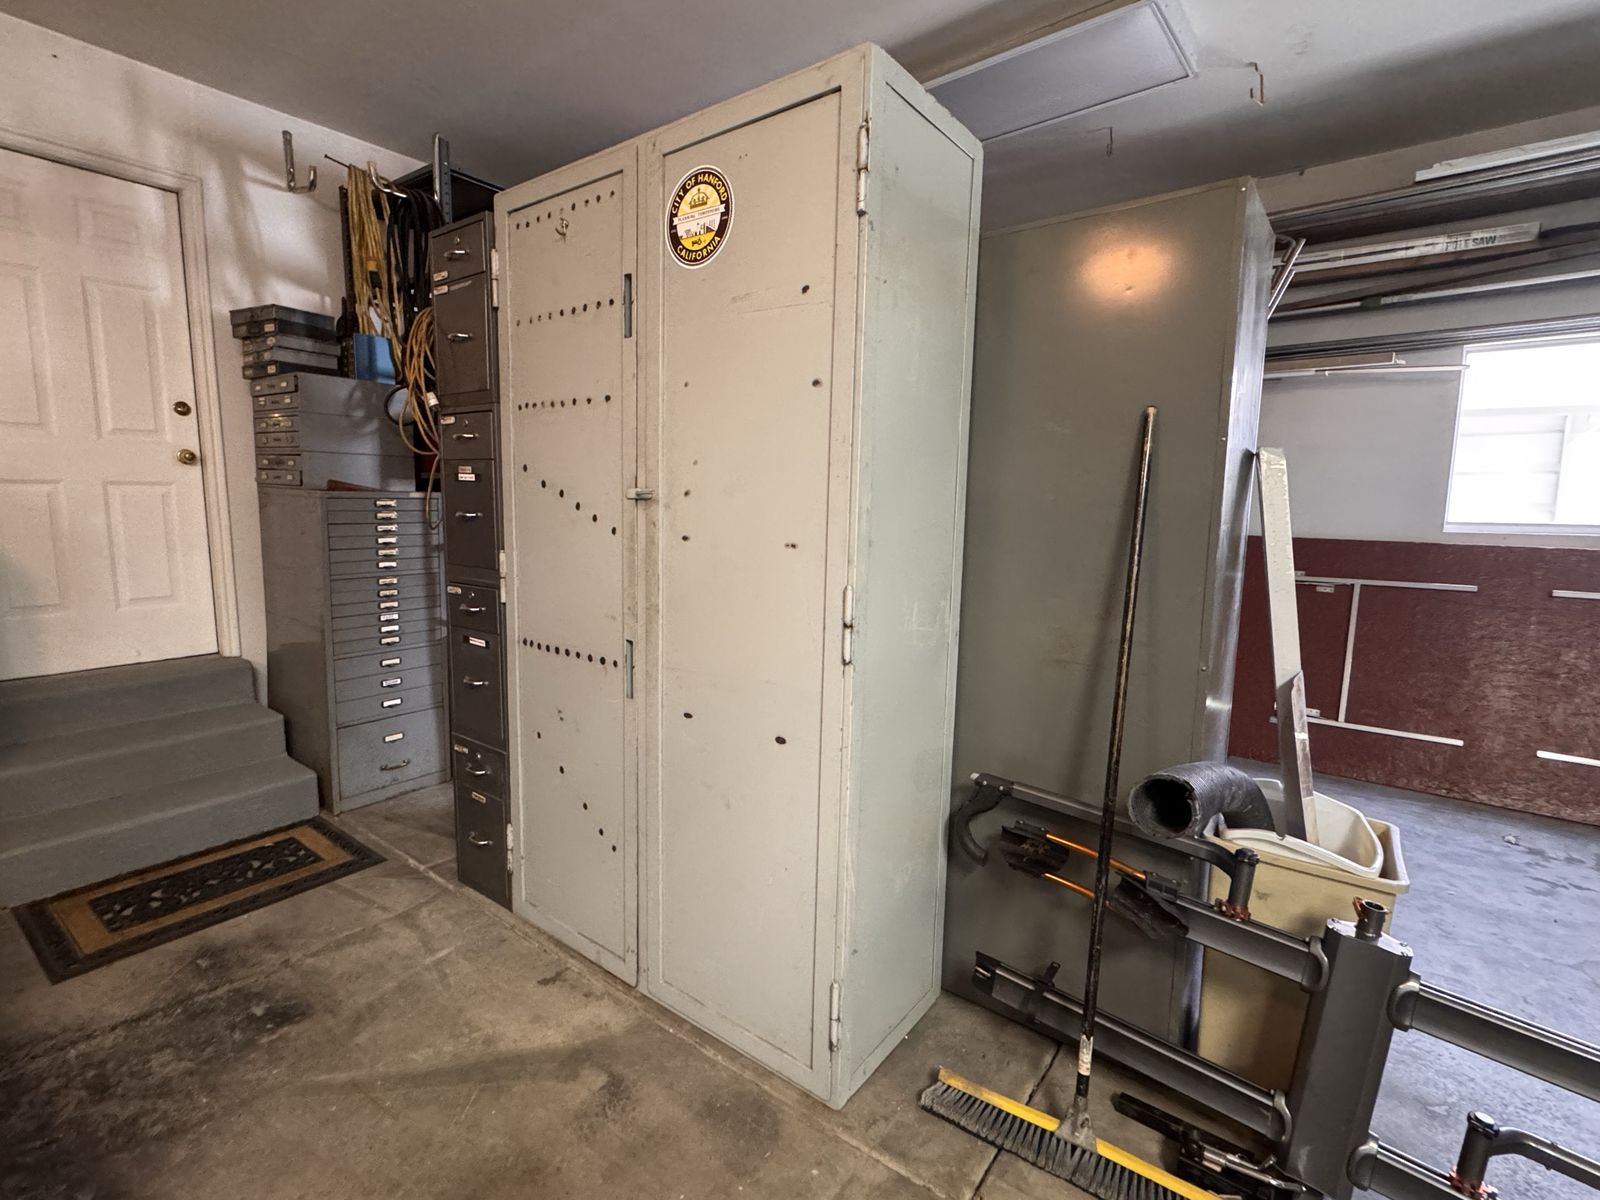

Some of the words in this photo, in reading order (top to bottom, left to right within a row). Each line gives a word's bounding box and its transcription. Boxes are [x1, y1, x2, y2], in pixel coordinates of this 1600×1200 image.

[671, 190, 685, 214] CITY
[685, 177, 696, 189] OF
[697, 174, 728, 201] HANFORD
[677, 236, 721, 261] CALIFORNIA
[1472, 235, 1497, 247] SAW
